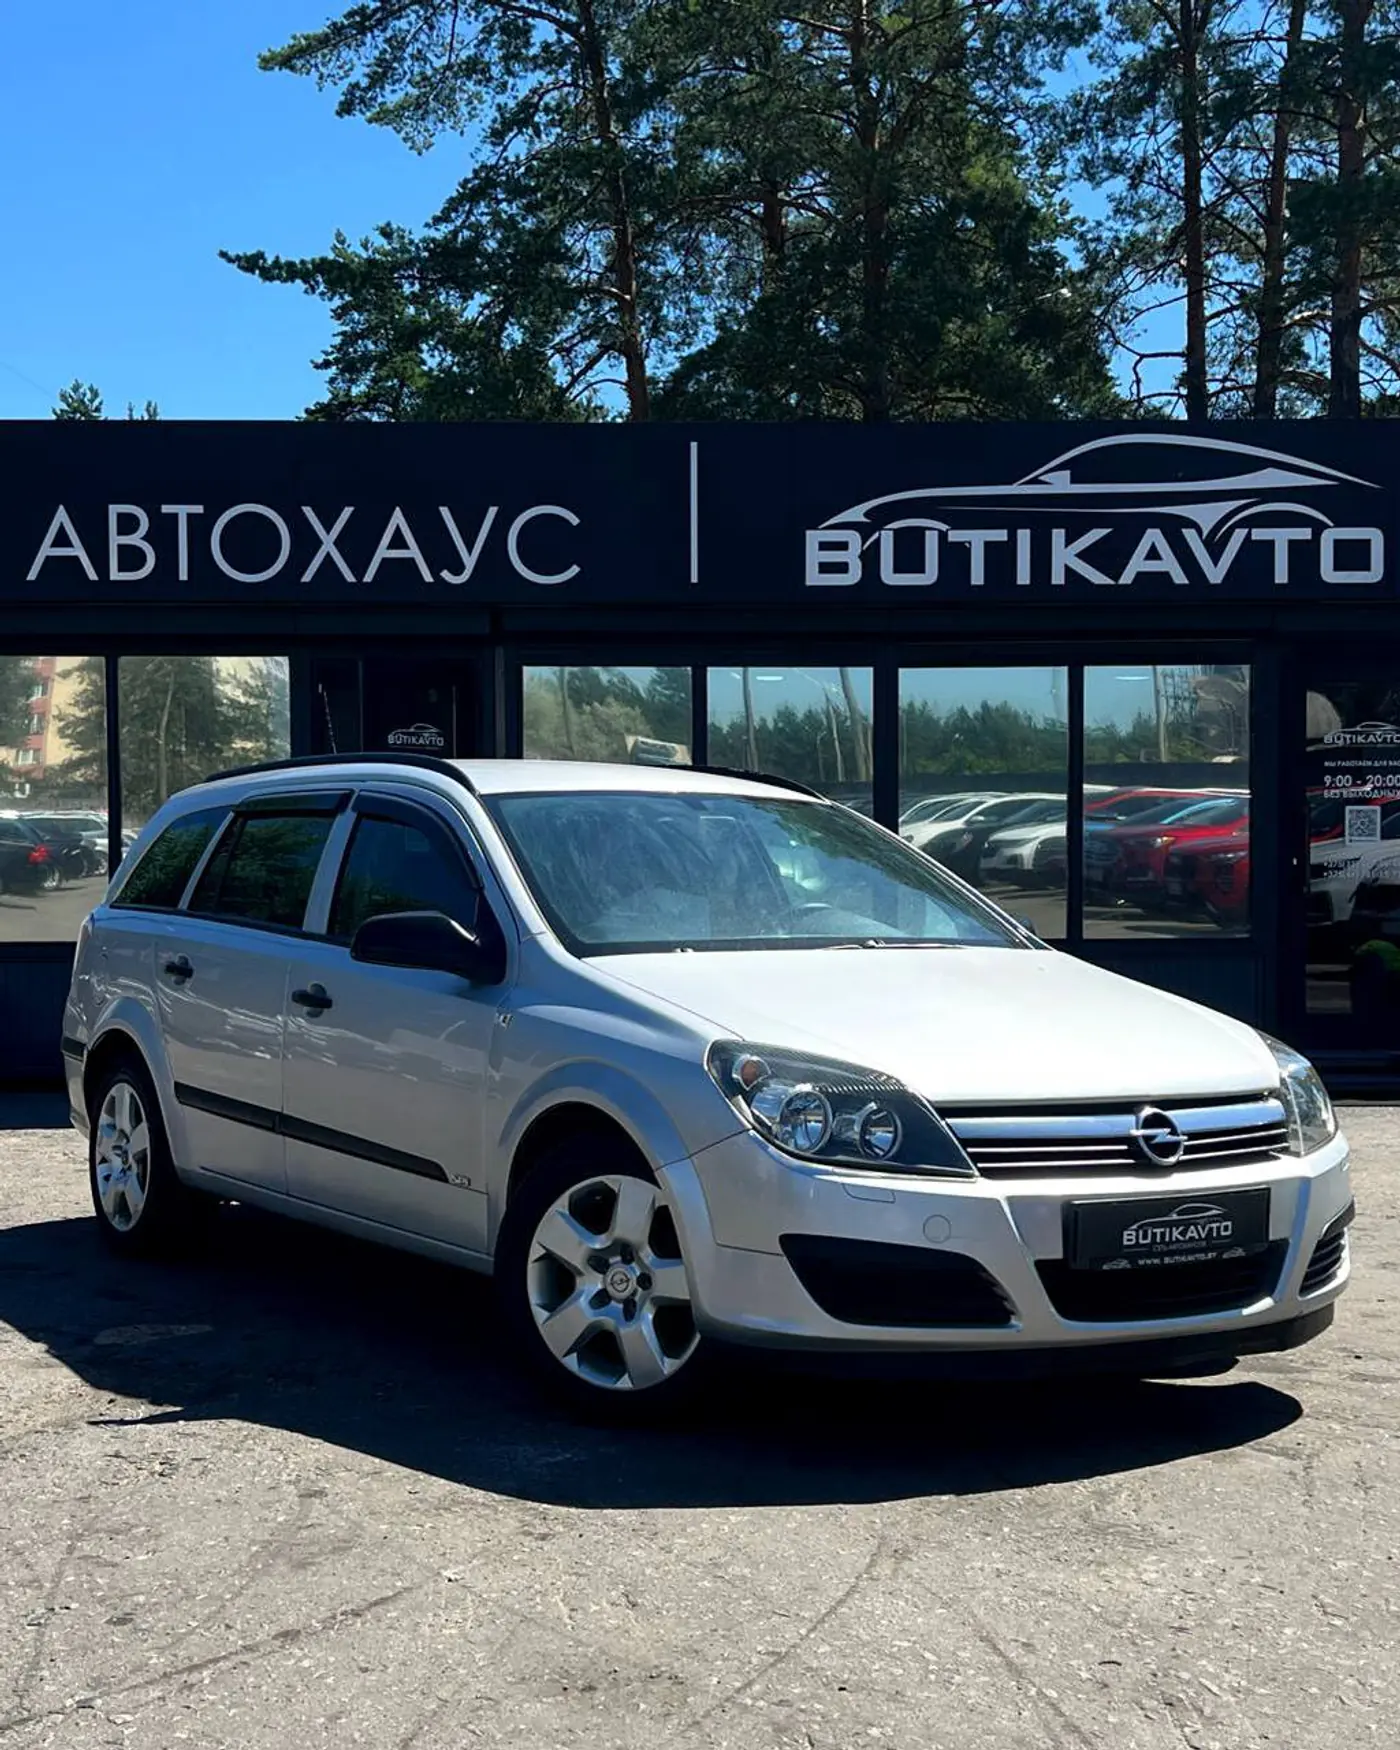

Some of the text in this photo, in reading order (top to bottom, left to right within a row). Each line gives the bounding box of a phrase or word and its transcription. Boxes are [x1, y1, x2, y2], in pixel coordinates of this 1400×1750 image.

[26, 503, 581, 584] АВТОХАУС
[805, 527, 1384, 586] BUTIKAVTO
[387, 734, 444, 746] BUTIKAVTO
[1323, 774, 1352, 787] 9:00
[1366, 774, 1400, 787] 20:00
[1122, 1221, 1233, 1245] BUTIKAVTO
